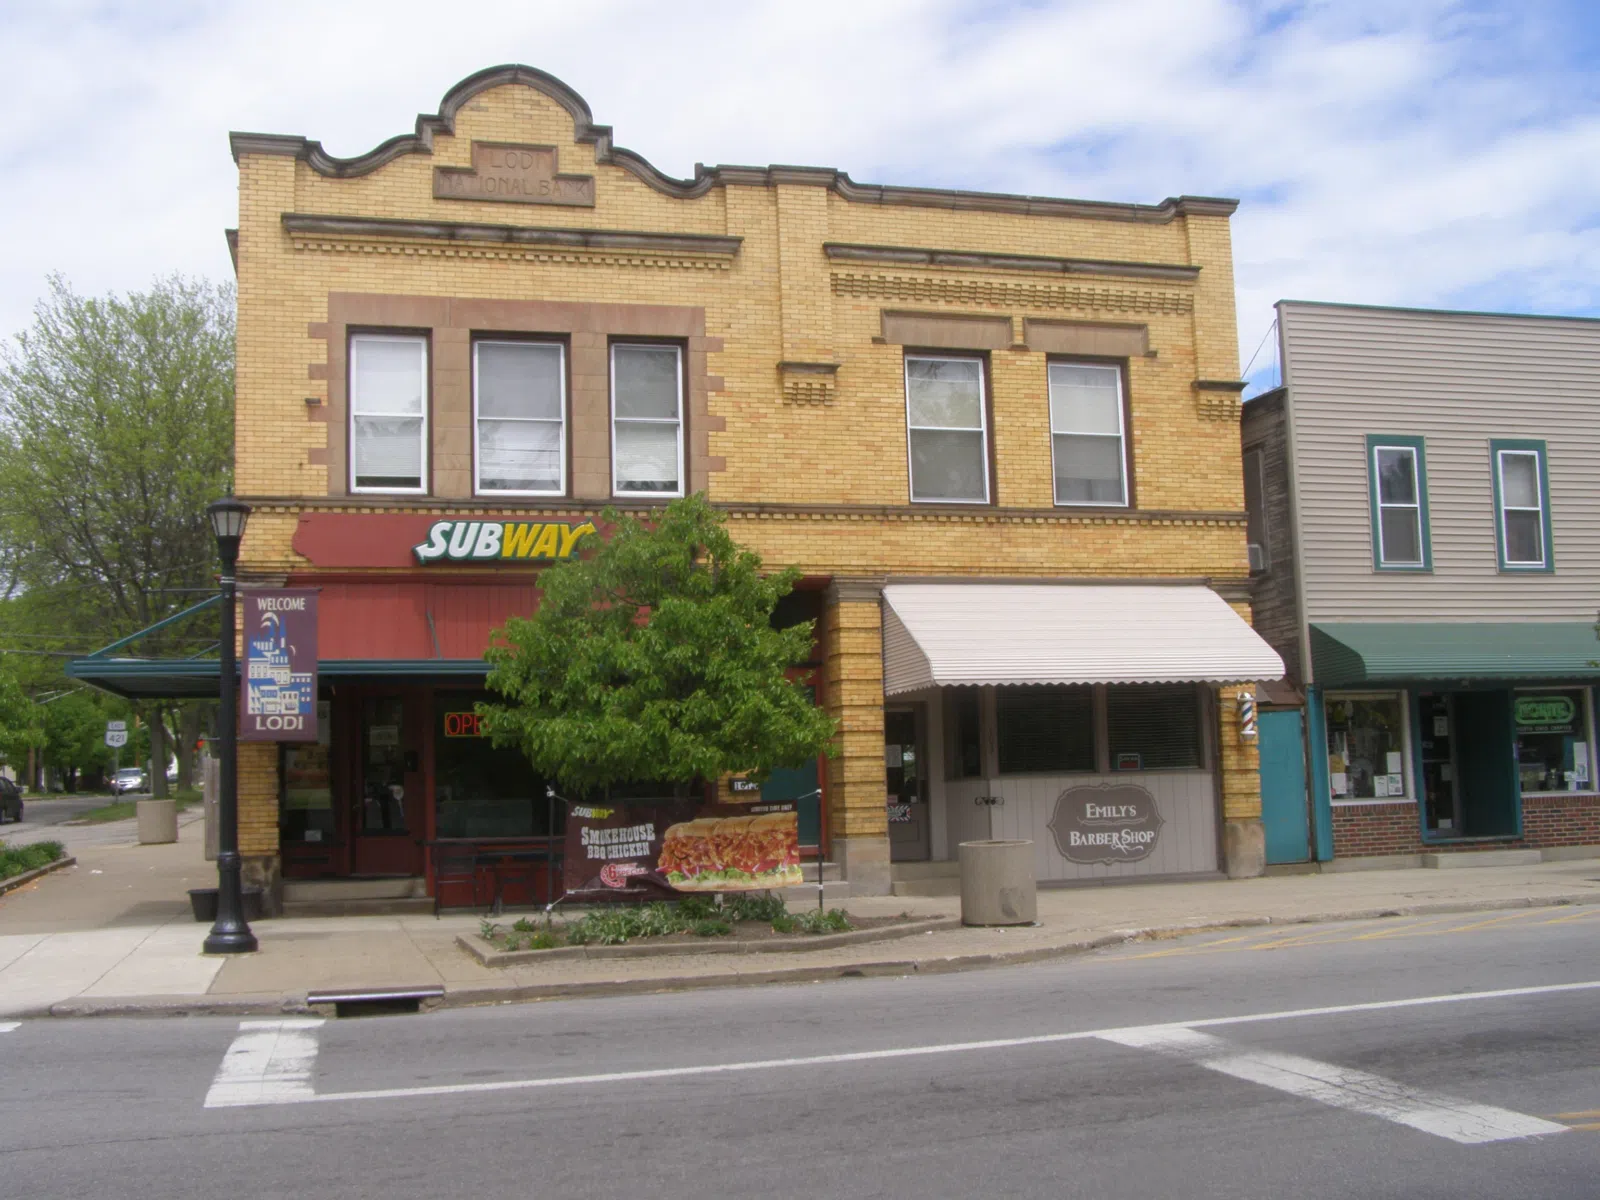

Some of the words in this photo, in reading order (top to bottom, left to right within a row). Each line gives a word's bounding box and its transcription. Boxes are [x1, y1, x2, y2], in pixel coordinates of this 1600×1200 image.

[416, 521, 597, 561] SUBWAY
[257, 597, 306, 611] WELCOME
[255, 715, 304, 730] LODI
[447, 713, 490, 736] OPE
[109, 734, 125, 743] 421
[571, 806, 615, 819] SUBWAY
[1085, 803, 1137, 818] EMILY'S
[581, 823, 656, 846] SMOKEHOUSE
[1070, 831, 1120, 847] BARBER
[1121, 828, 1155, 844] SHOP
[587, 845, 607, 860] BBQ
[607, 841, 650, 859] CHICKEN
